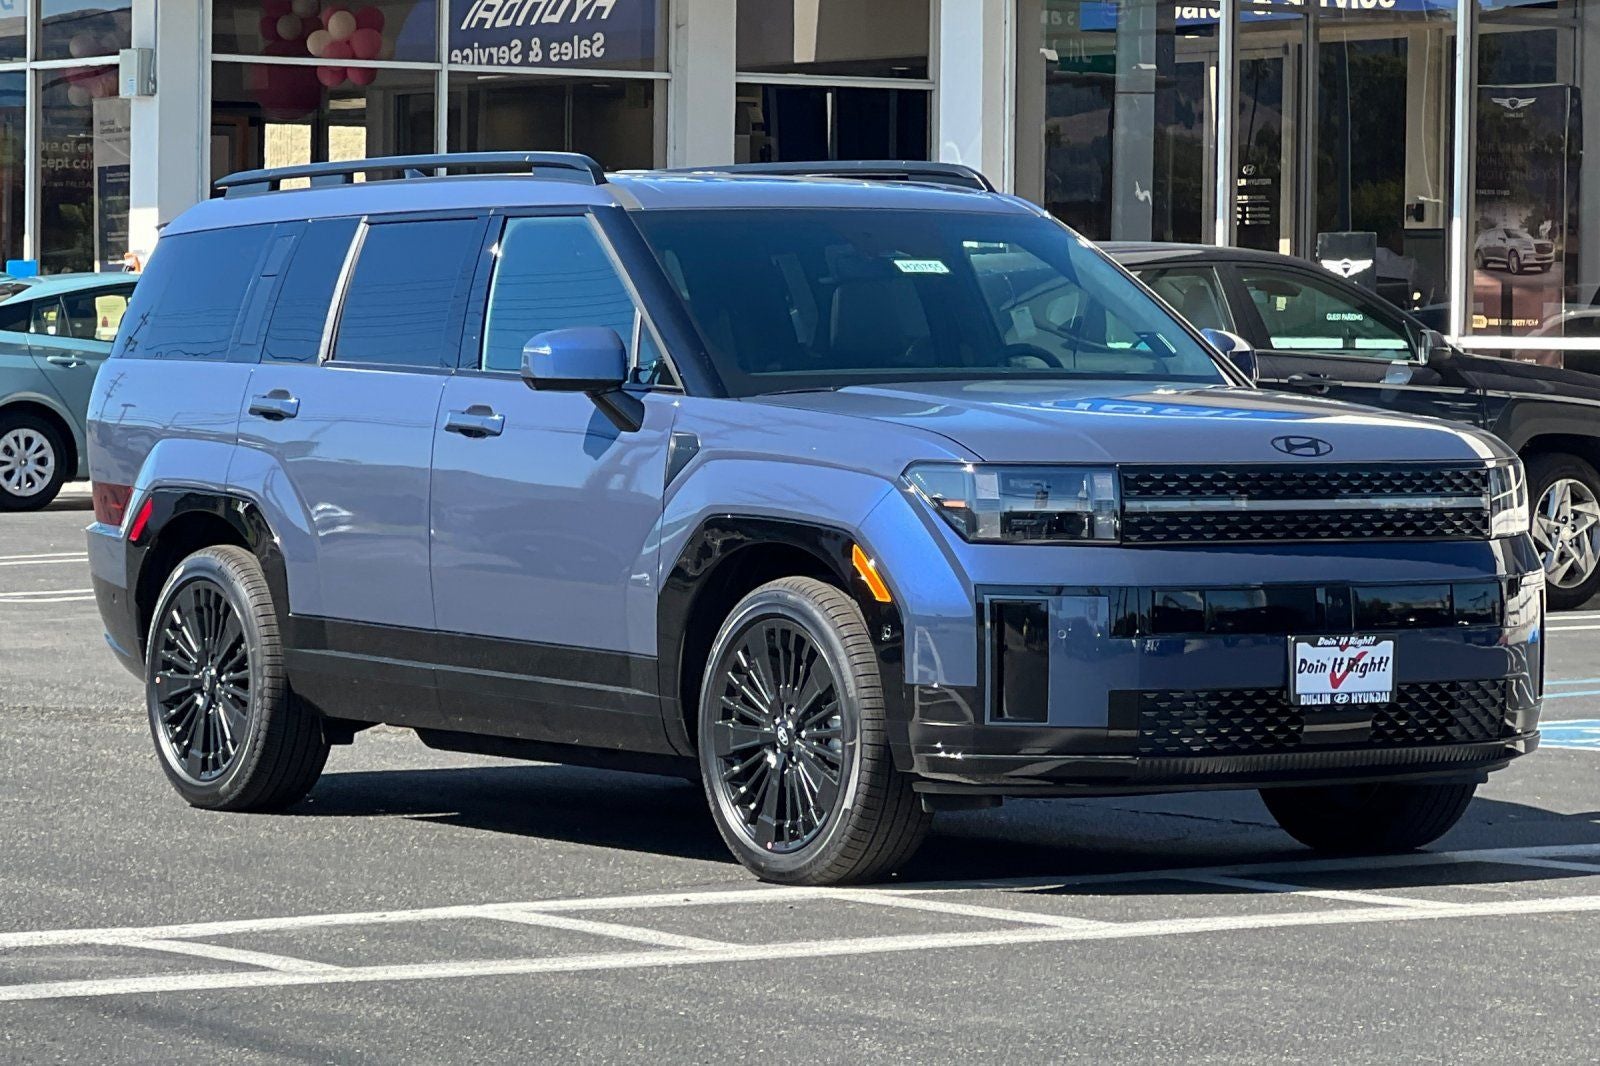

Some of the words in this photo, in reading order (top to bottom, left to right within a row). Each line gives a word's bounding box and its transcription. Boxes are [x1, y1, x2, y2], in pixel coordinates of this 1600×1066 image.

[1317, 637, 1339, 646] Doin'
[1339, 636, 1348, 646] It
[1348, 636, 1376, 648] Right!
[1297, 656, 1331, 675] Doin'
[1331, 657, 1345, 673] It
[1347, 655, 1390, 679] Right!
[1300, 693, 1331, 706] DUBLIN
[1351, 691, 1390, 704] HYUNDAI
